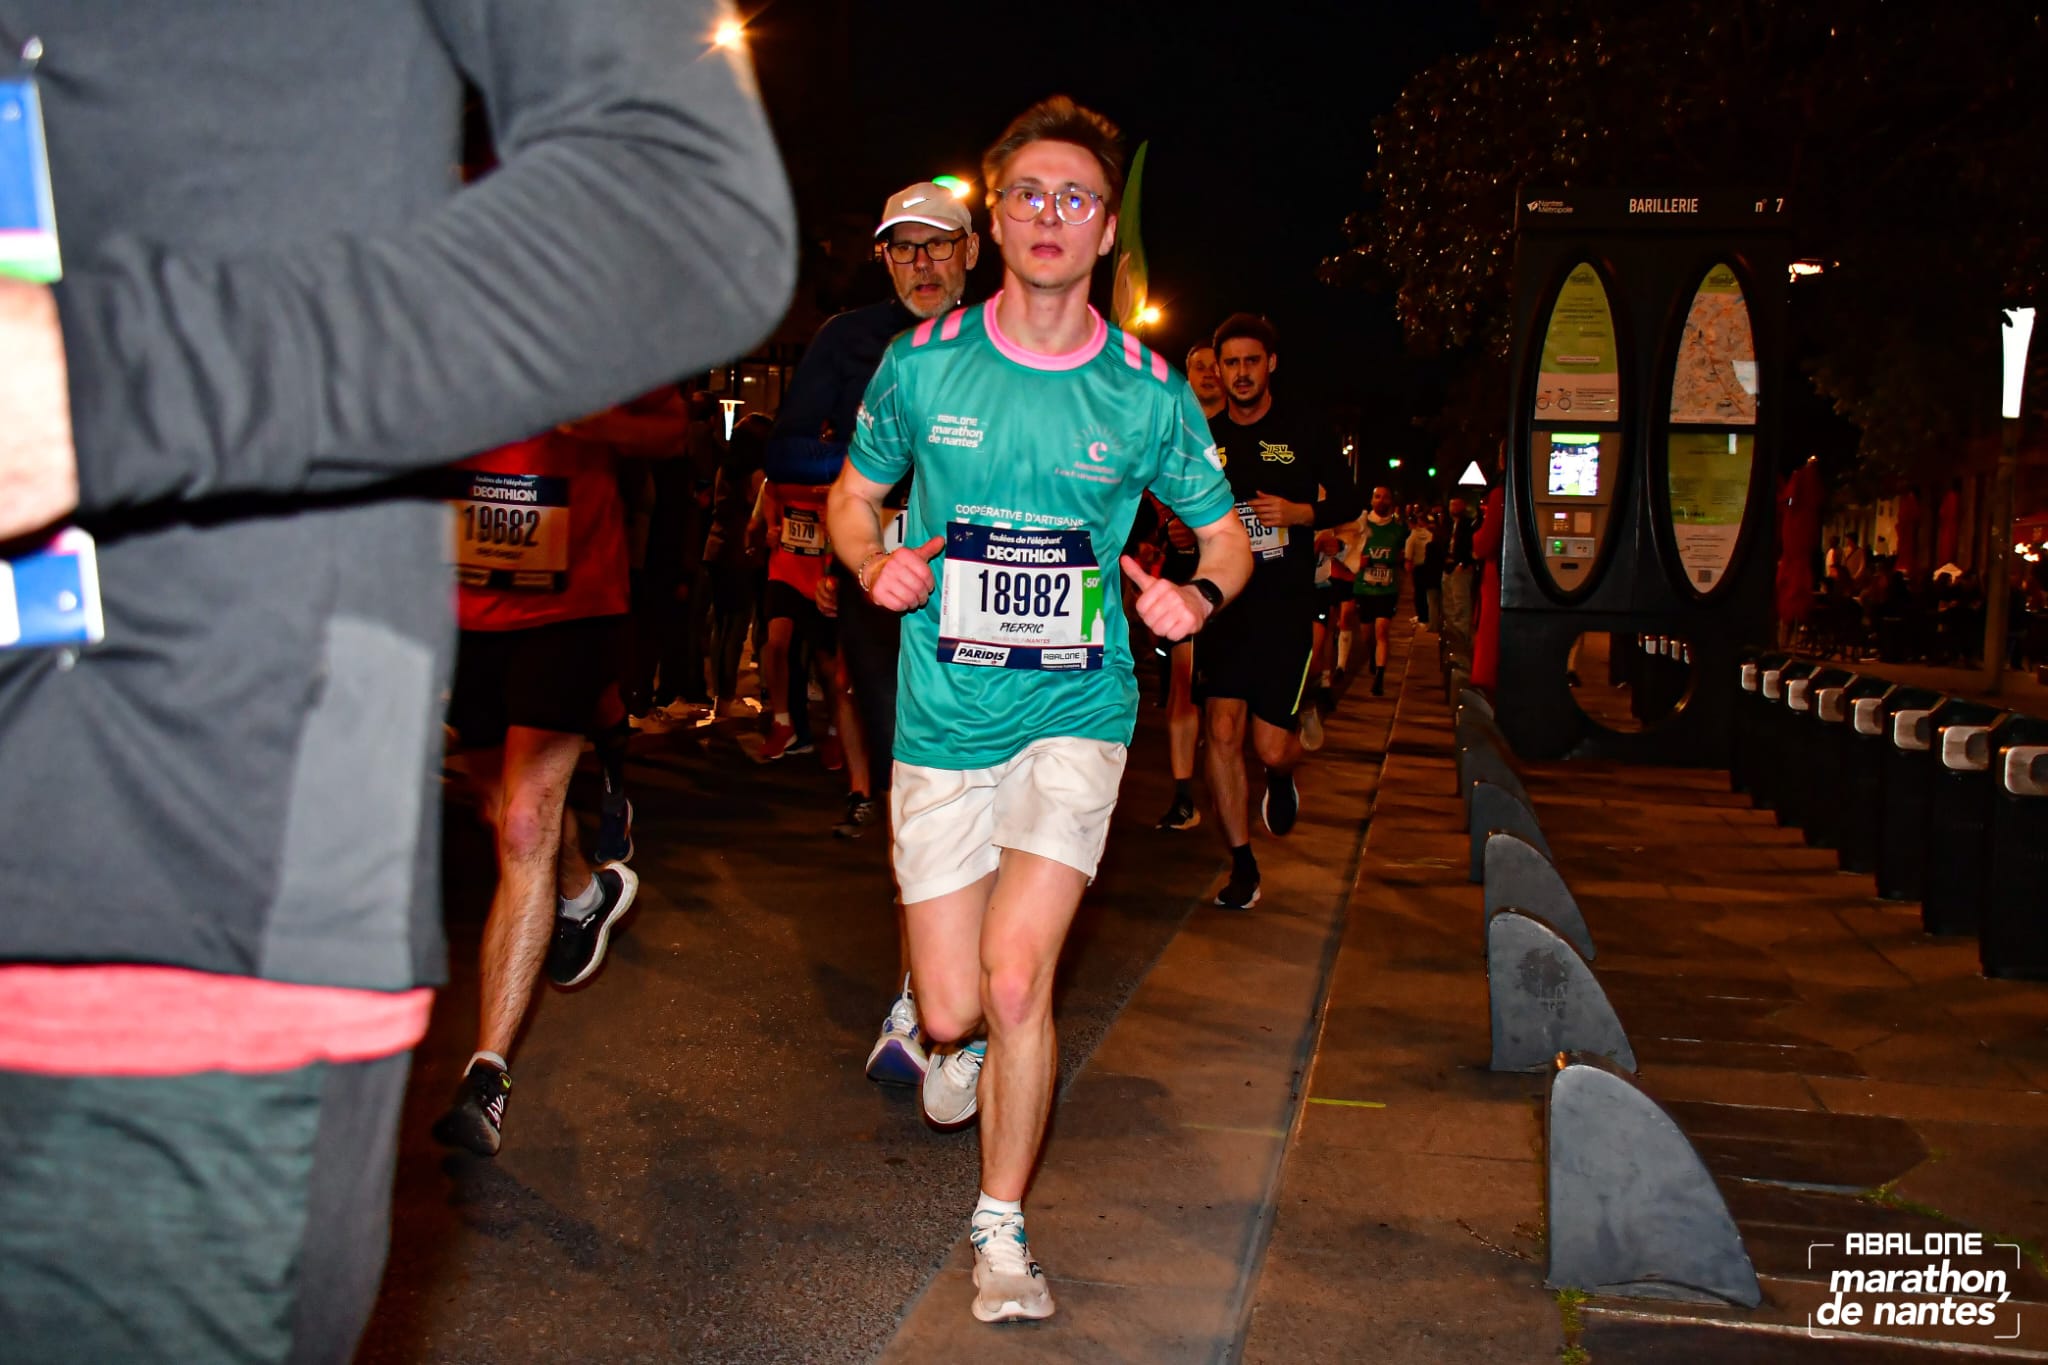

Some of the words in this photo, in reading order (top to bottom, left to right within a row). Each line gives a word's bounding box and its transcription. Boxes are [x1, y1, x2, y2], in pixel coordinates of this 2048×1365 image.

[1629, 198, 1698, 213] BARILLERIE
[1776, 198, 1784, 212] 7
[932, 425, 983, 439] marathon
[928, 432, 941, 444] de
[942, 436, 978, 448] nantes
[473, 485, 538, 502] DECATHLON
[955, 503, 1022, 521] COOPÉRATIVE
[464, 505, 541, 547] 19682
[989, 532, 1015, 543] foulées
[1015, 535, 1026, 544] de
[987, 545, 1066, 563] DECATHLON
[978, 569, 1071, 617] 18982
[1000, 622, 1044, 634] PIERRIC
[958, 647, 1005, 661] PARIDIS
[1043, 652, 1080, 660] ABALONE
